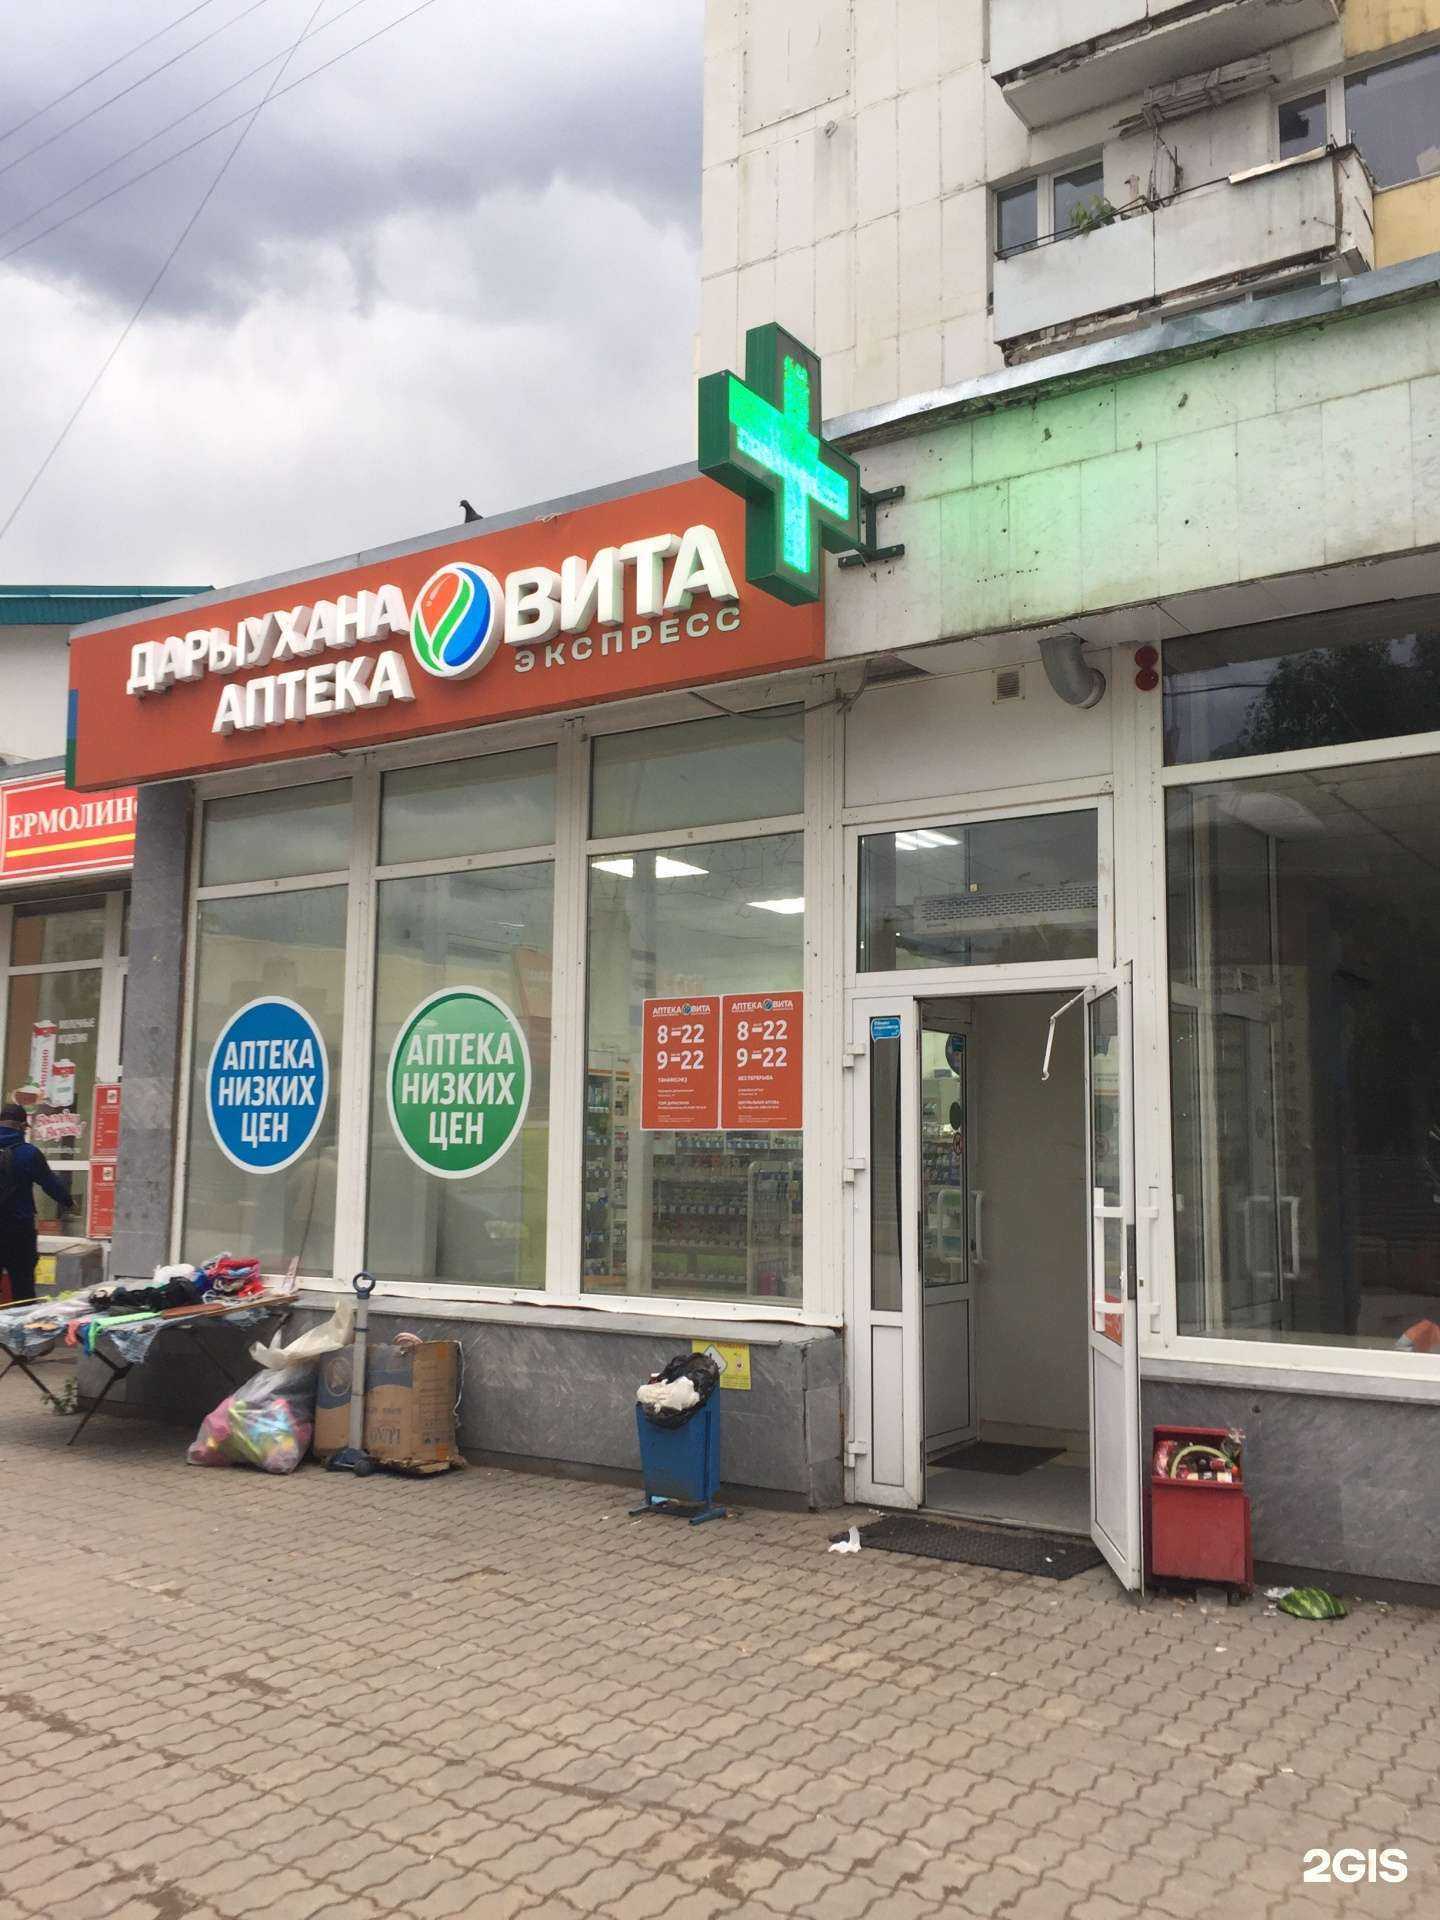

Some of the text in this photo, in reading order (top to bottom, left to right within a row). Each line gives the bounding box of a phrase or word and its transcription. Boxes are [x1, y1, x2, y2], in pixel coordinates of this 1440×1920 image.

[504, 524, 740, 647] ВИТА
[126, 583, 411, 696] ДАРЫУХАНА
[514, 607, 741, 673] ЭКСПРЕСС
[211, 650, 416, 736] АПТЕКА
[8, 795, 137, 840] ЕРМОЛИН
[652, 1004, 711, 1014] АПТЕКА ВИТА
[731, 999, 794, 1011] АПТЕКА ВИТА
[222, 1038, 315, 1071] АПТЕКА
[406, 1032, 515, 1067] АПТЕКА
[218, 1075, 316, 1106] НИЗКИХ
[402, 1072, 516, 1106] НИЗКИХ
[241, 1112, 289, 1149] ЦЕН
[428, 1111, 485, 1151] ЦЕН
